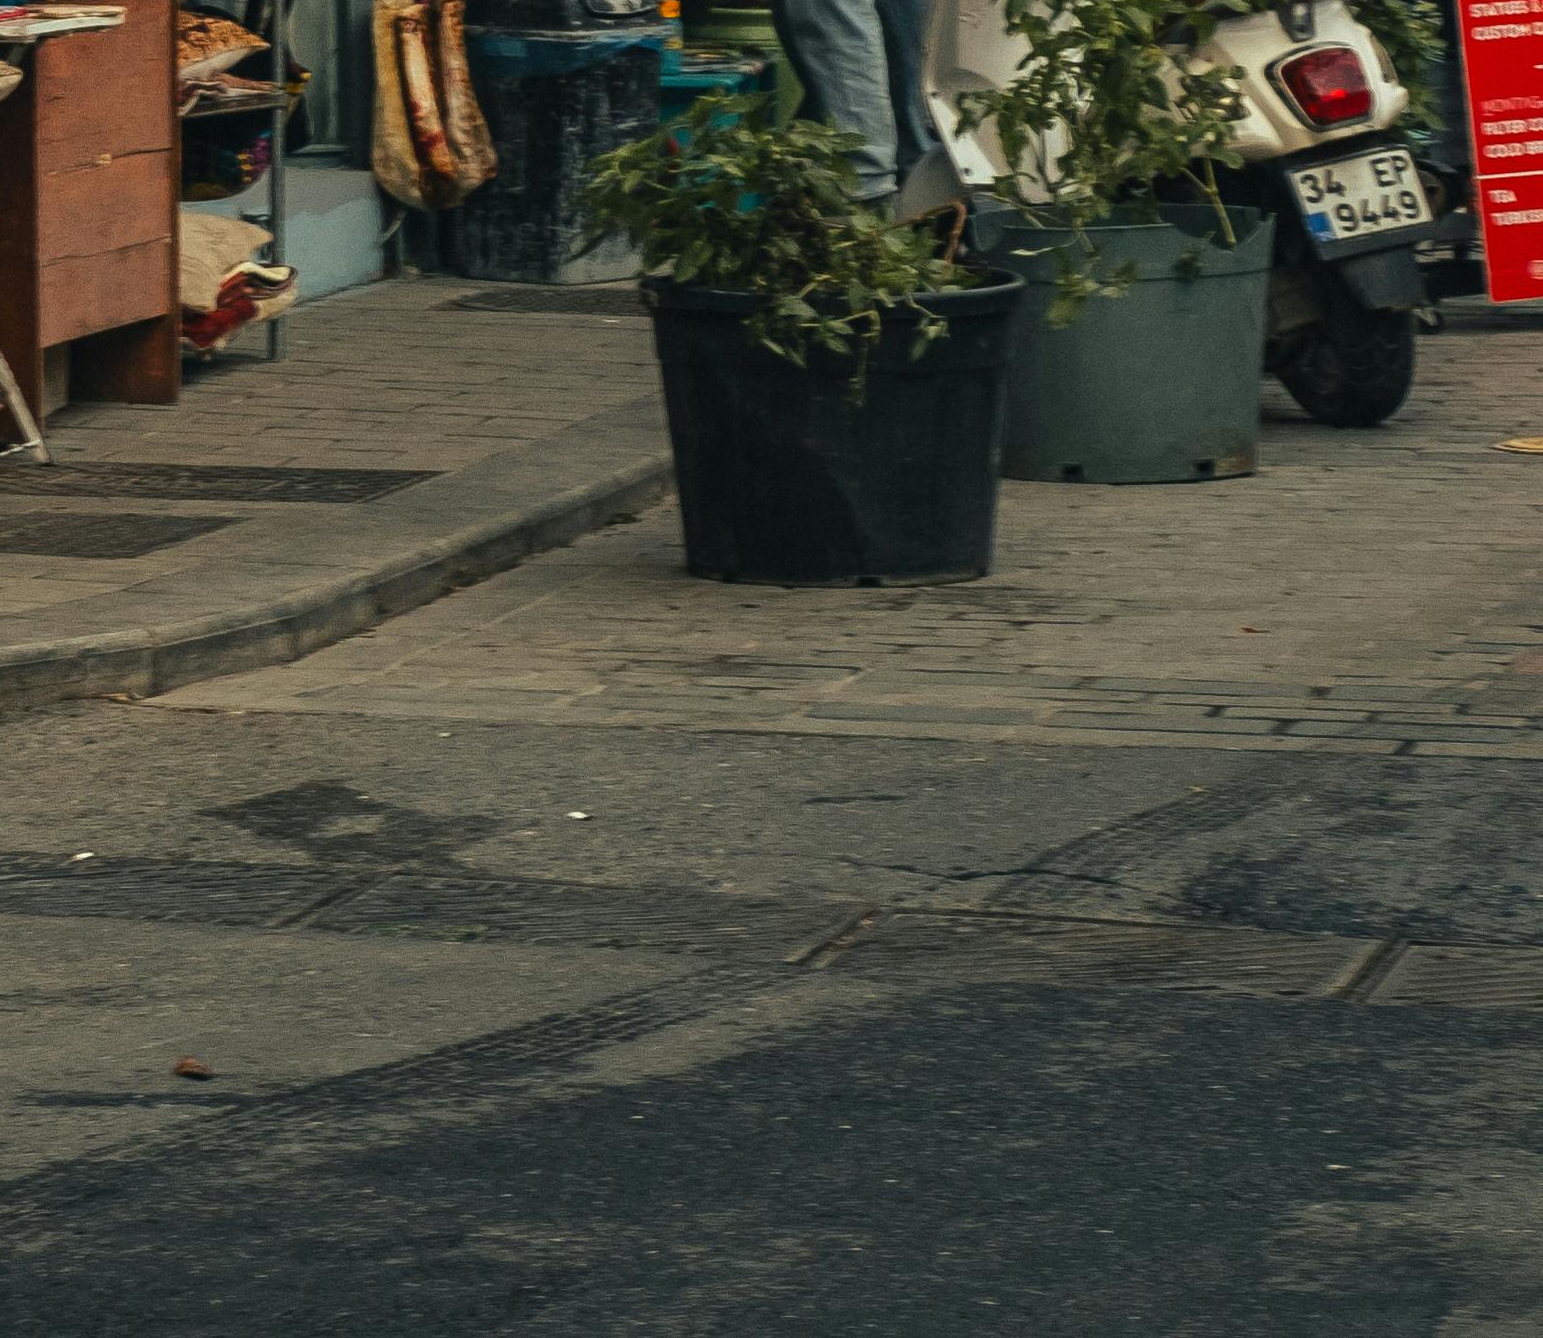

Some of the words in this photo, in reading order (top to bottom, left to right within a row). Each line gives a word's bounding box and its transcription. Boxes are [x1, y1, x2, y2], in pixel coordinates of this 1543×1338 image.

[1299, 169, 1347, 204] 34
[1370, 154, 1408, 187] EP
[1335, 189, 1420, 232] 9449
